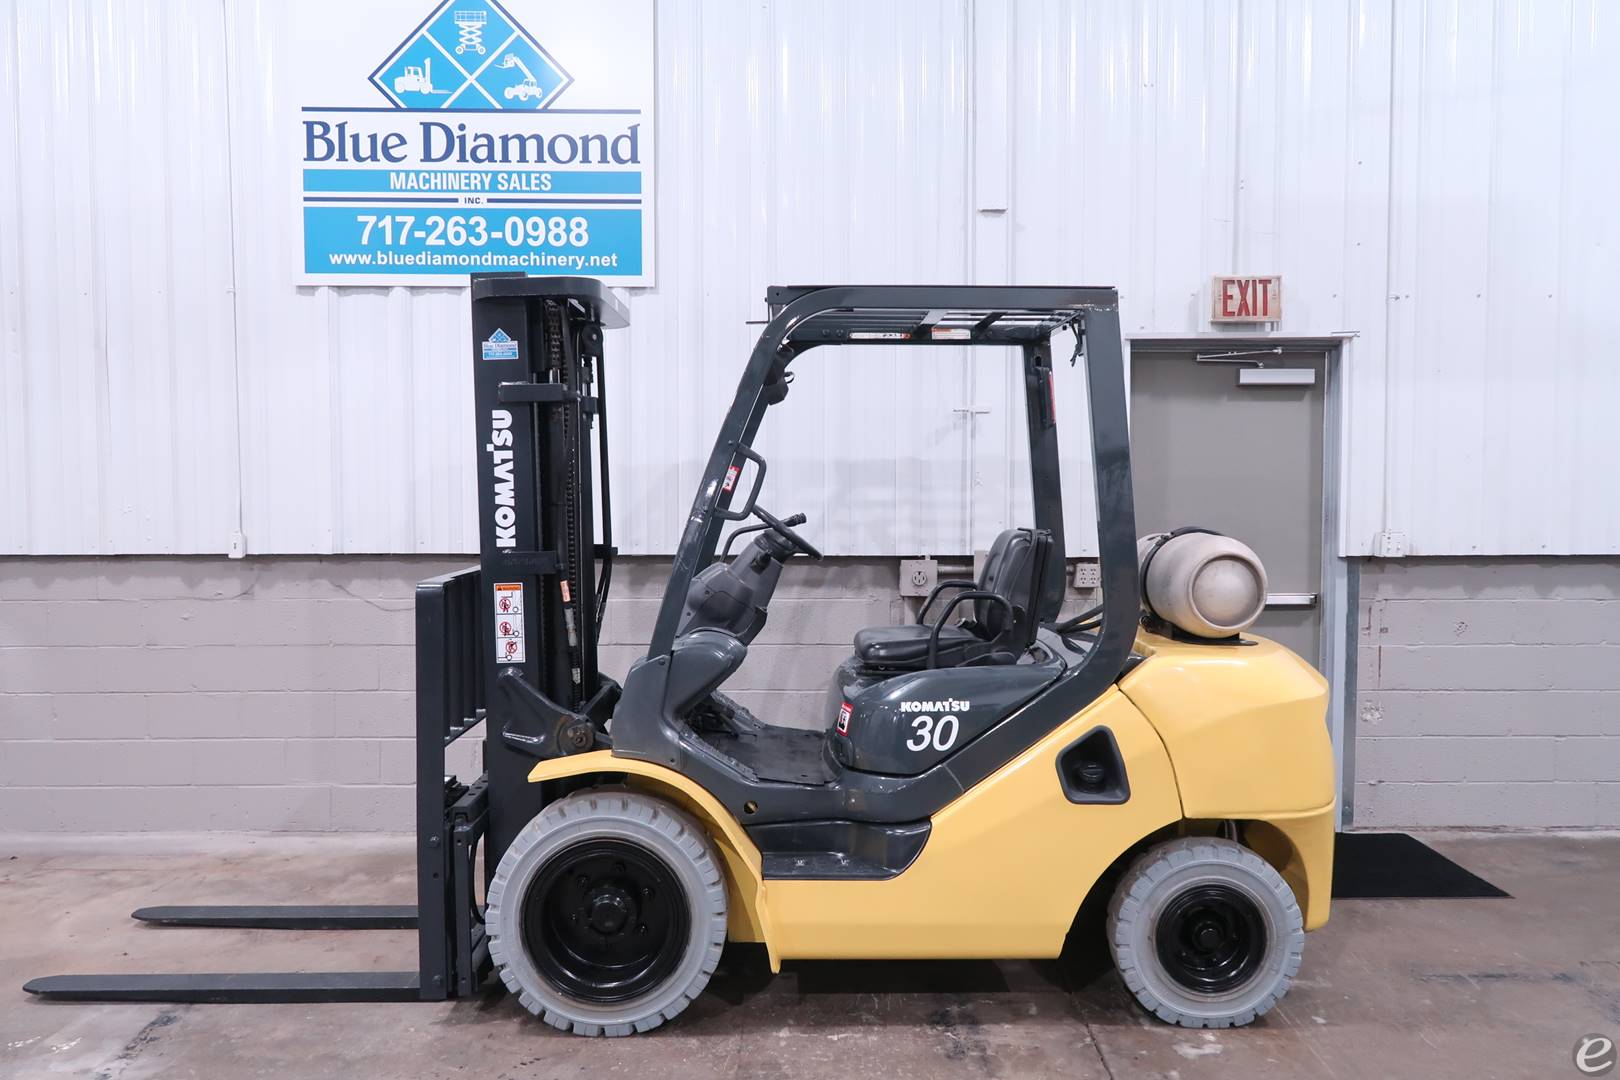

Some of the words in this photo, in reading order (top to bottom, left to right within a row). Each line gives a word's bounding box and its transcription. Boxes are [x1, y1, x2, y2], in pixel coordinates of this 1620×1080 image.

[303, 120, 407, 163] Blue
[419, 121, 641, 165] Diamond
[390, 172, 492, 191] MACHINERY
[497, 172, 552, 192] SALES
[464, 196, 484, 205] INC.
[357, 214, 589, 247] 717-263-0988
[329, 250, 618, 271] www.bluediamondmachinery.net
[1222, 279, 1272, 317] EXIT
[486, 409, 516, 548] KOMATSU
[900, 698, 970, 713] KOMATSU
[906, 714, 960, 752] 30
